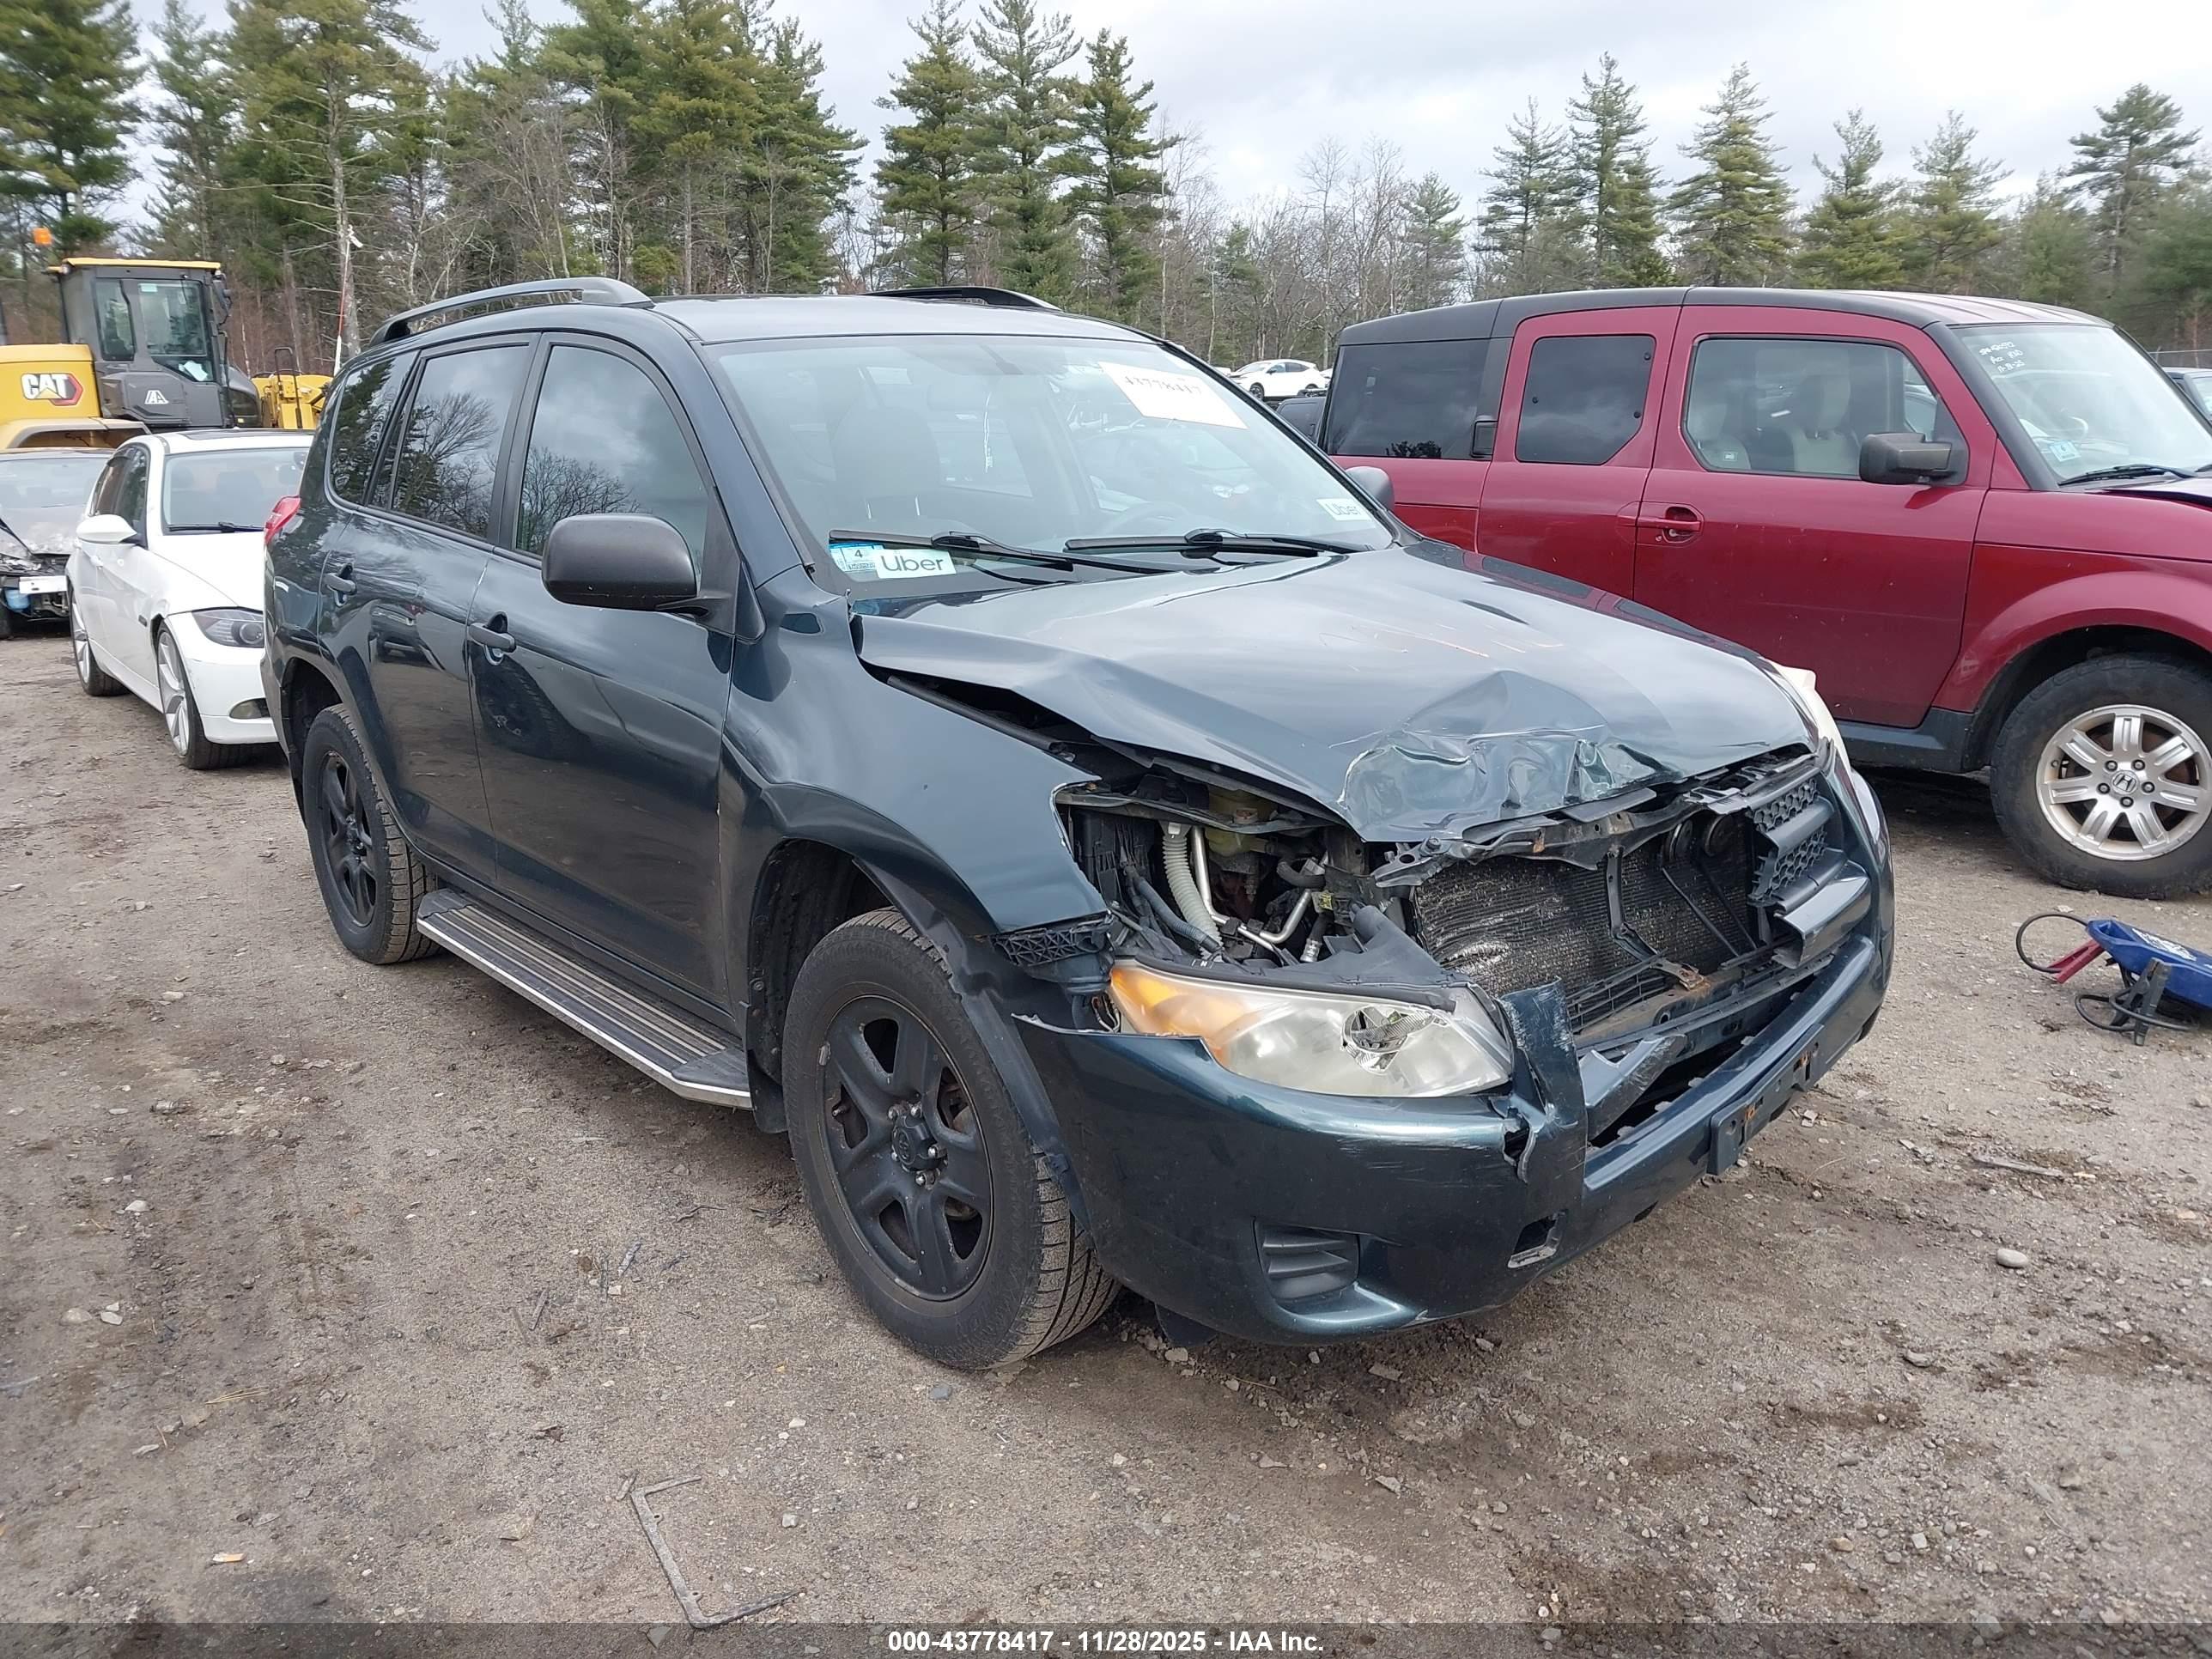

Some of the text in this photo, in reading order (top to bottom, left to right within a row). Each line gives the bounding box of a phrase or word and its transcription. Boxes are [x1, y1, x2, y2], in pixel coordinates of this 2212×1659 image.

[21, 374, 69, 399] CAT
[854, 549, 863, 558] 4
[880, 556, 944, 572] Uber
